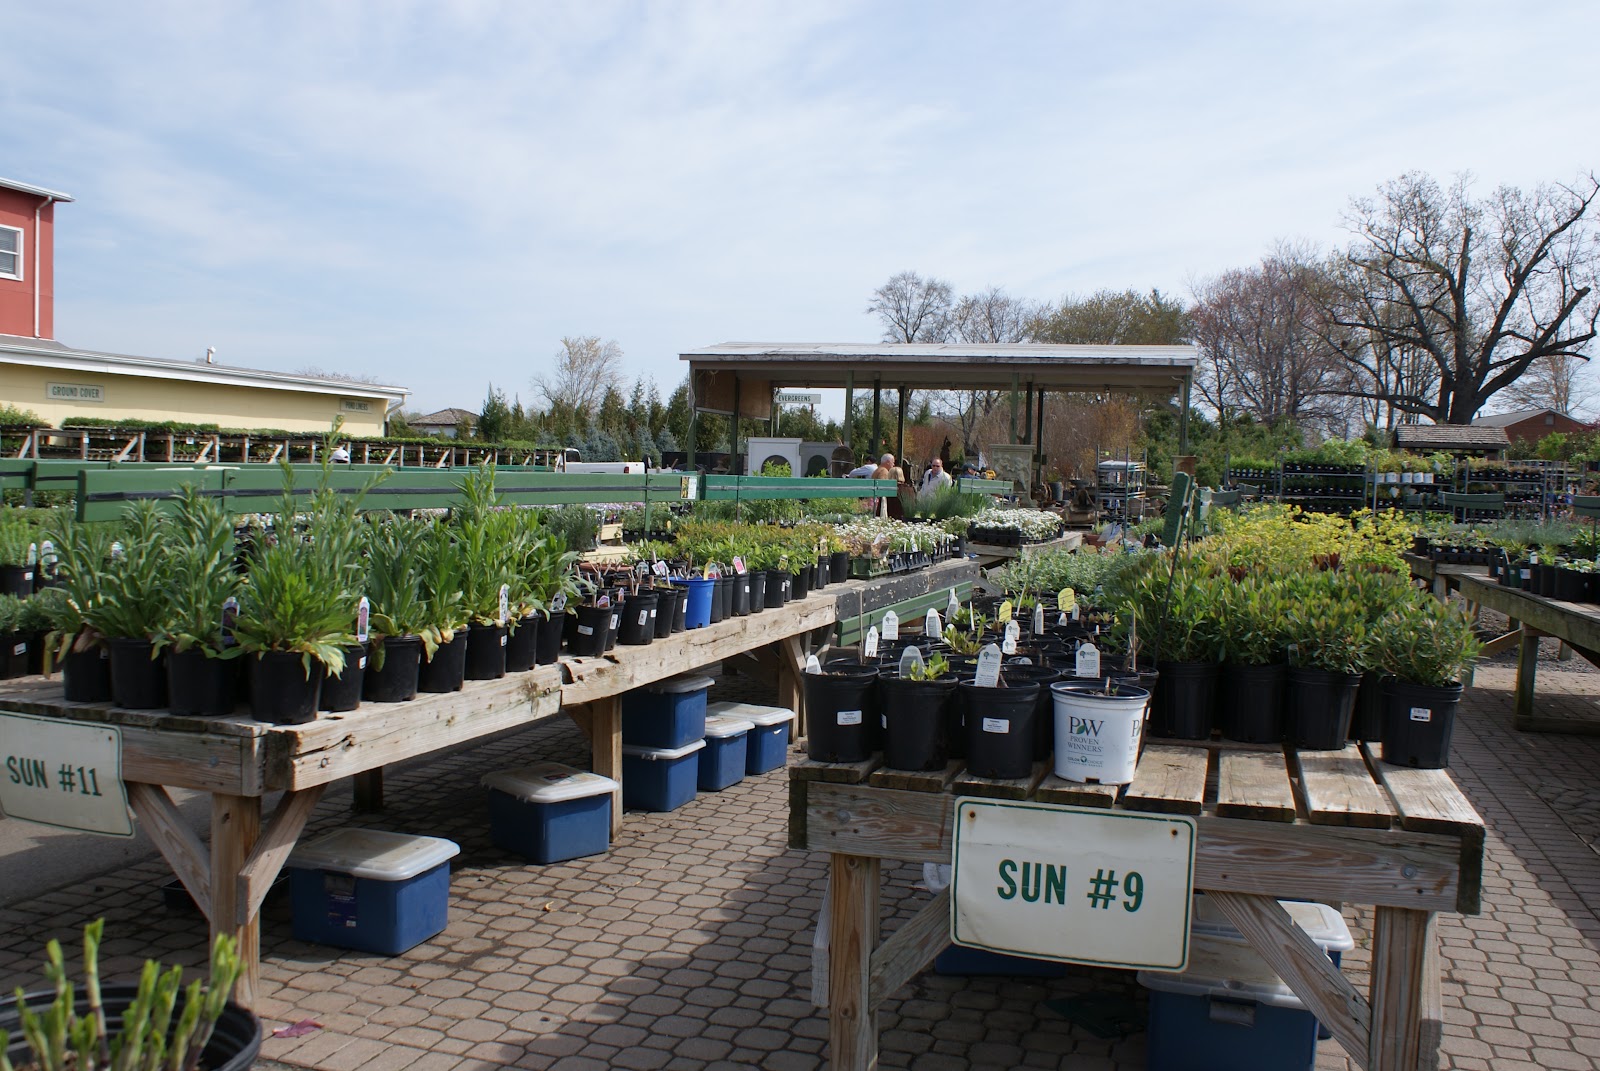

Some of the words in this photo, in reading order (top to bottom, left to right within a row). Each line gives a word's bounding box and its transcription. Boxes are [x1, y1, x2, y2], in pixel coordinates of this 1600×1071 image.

[52, 386, 78, 397] GROUND
[80, 387, 100, 399] COVER
[778, 394, 811, 402] EVERGREENS
[1070, 735, 1099, 746] PROVEN
[1067, 741, 1103, 753] WINNERS
[7, 755, 49, 789] SUN
[58, 763, 103, 797] #11
[997, 858, 1067, 905] SUN
[1087, 868, 1144, 913] #9
